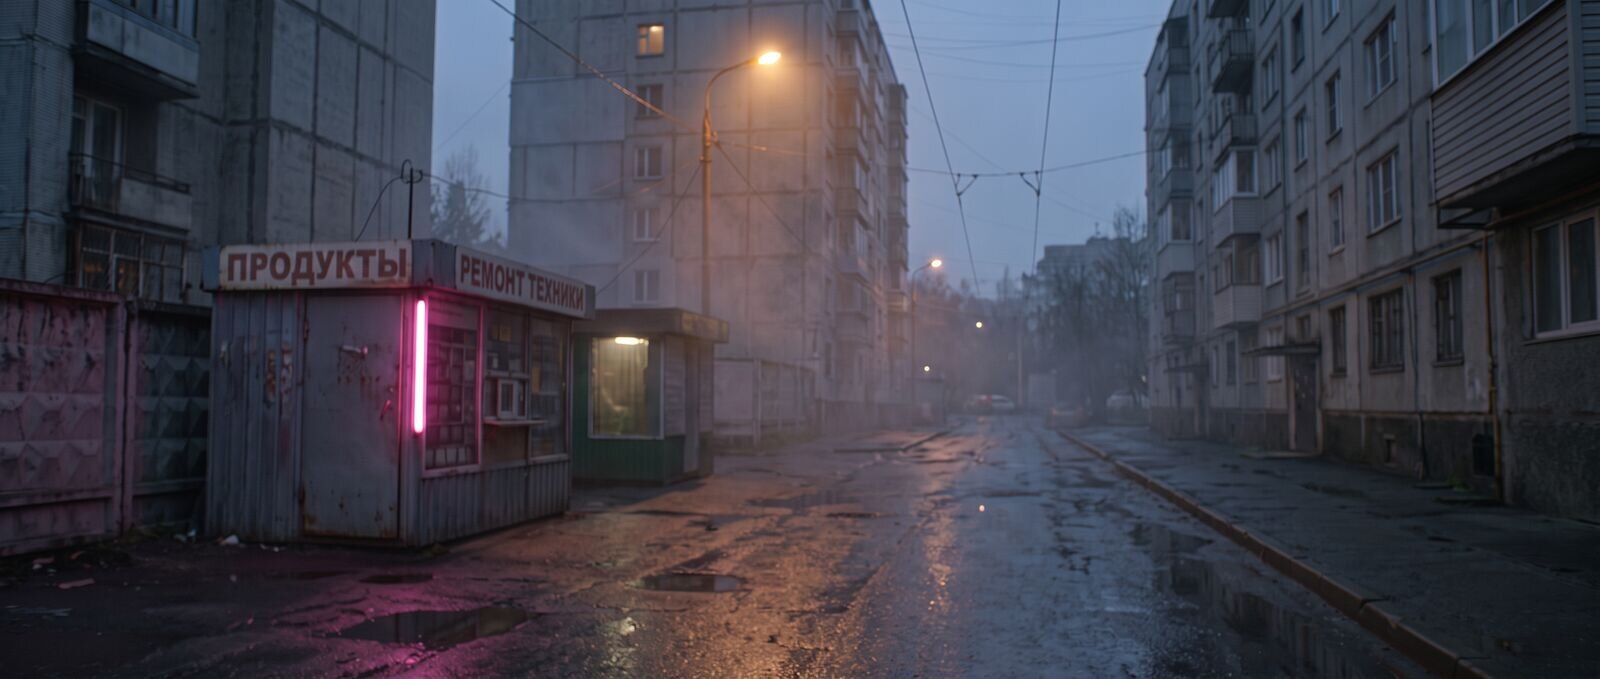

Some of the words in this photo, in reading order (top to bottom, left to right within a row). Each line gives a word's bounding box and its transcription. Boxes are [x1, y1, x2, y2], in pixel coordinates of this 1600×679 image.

[227, 248, 407, 286] ПРОДУКТЫ
[460, 254, 525, 297] РЕМОНТ
[528, 273, 584, 312] ТЕХНИКИ
